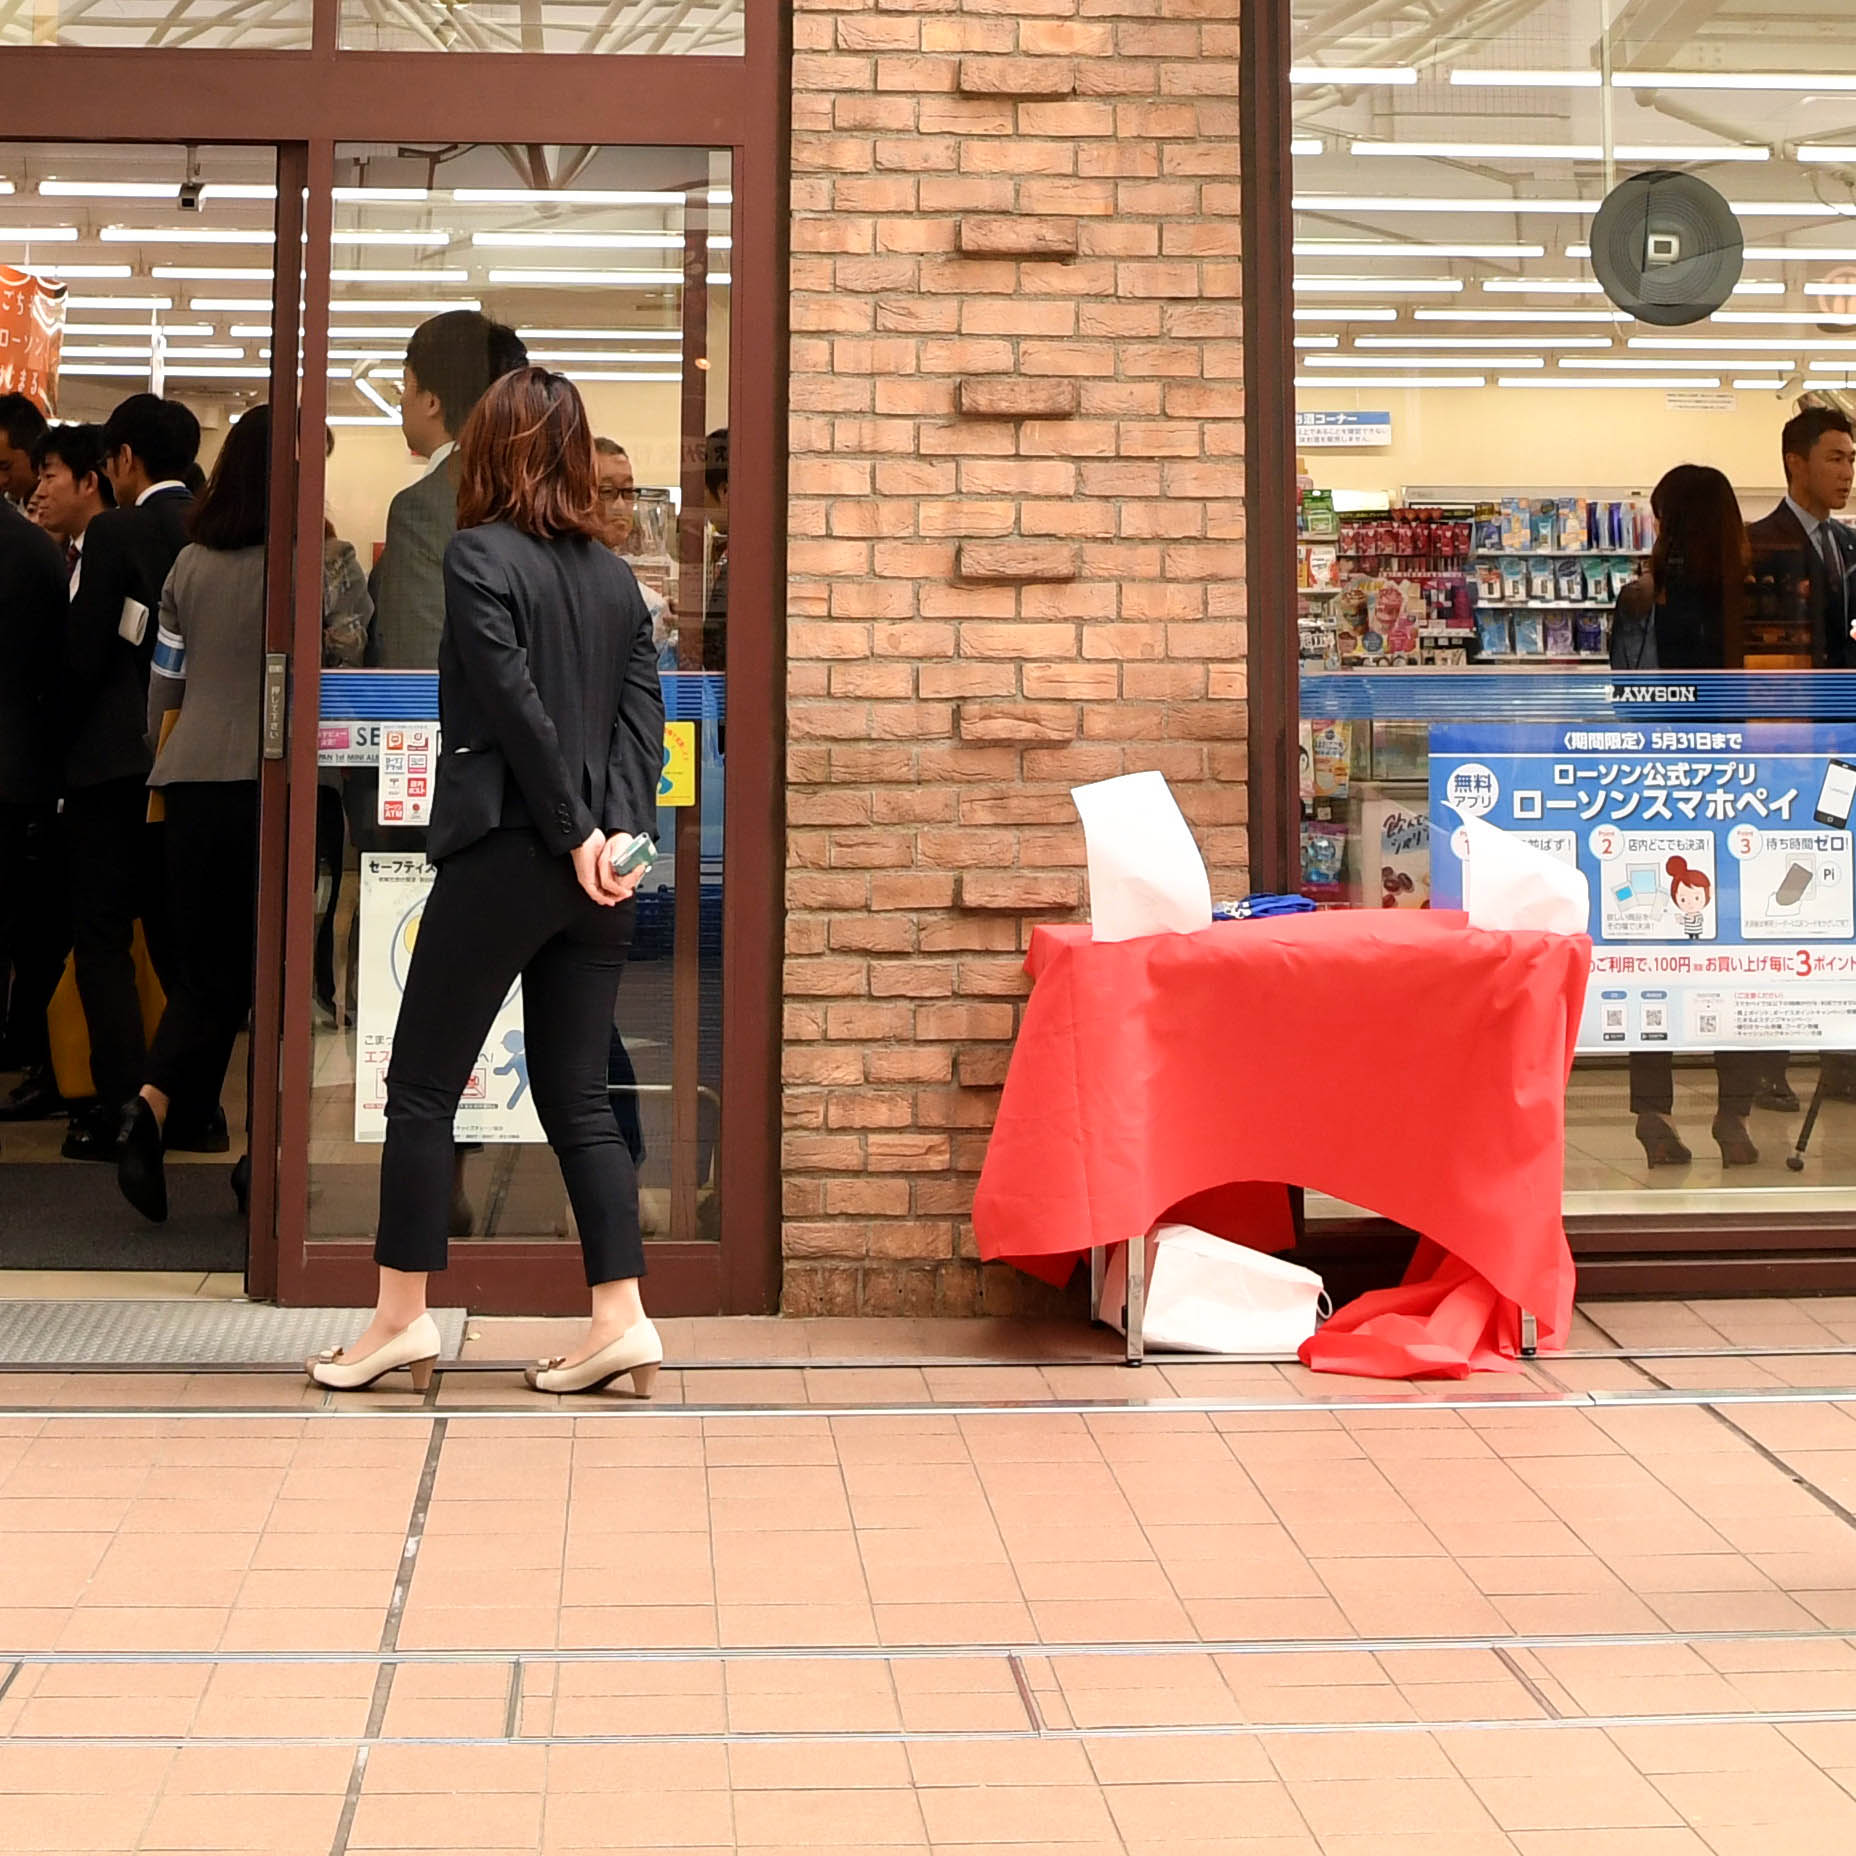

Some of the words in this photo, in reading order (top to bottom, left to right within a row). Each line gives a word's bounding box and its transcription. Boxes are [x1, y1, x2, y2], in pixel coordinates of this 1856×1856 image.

[0, 329, 44, 355] ローソン
[1605, 685, 1696, 702] LAWSON
[356, 727, 381, 746] SE
[1553, 762, 1757, 787] ローソン公式アプリ
[1453, 773, 1492, 794] 無料
[1454, 795, 1492, 809] アプリ
[1512, 788, 1799, 822] ローソンスマホペイ
[1601, 838, 1613, 855] 2
[1628, 838, 1710, 852] 店内どこでも決済!
[1739, 838, 1751, 854] 3
[1766, 835, 1849, 852] 待ち時間ゼロ!
[1823, 867, 1835, 881] Pi
